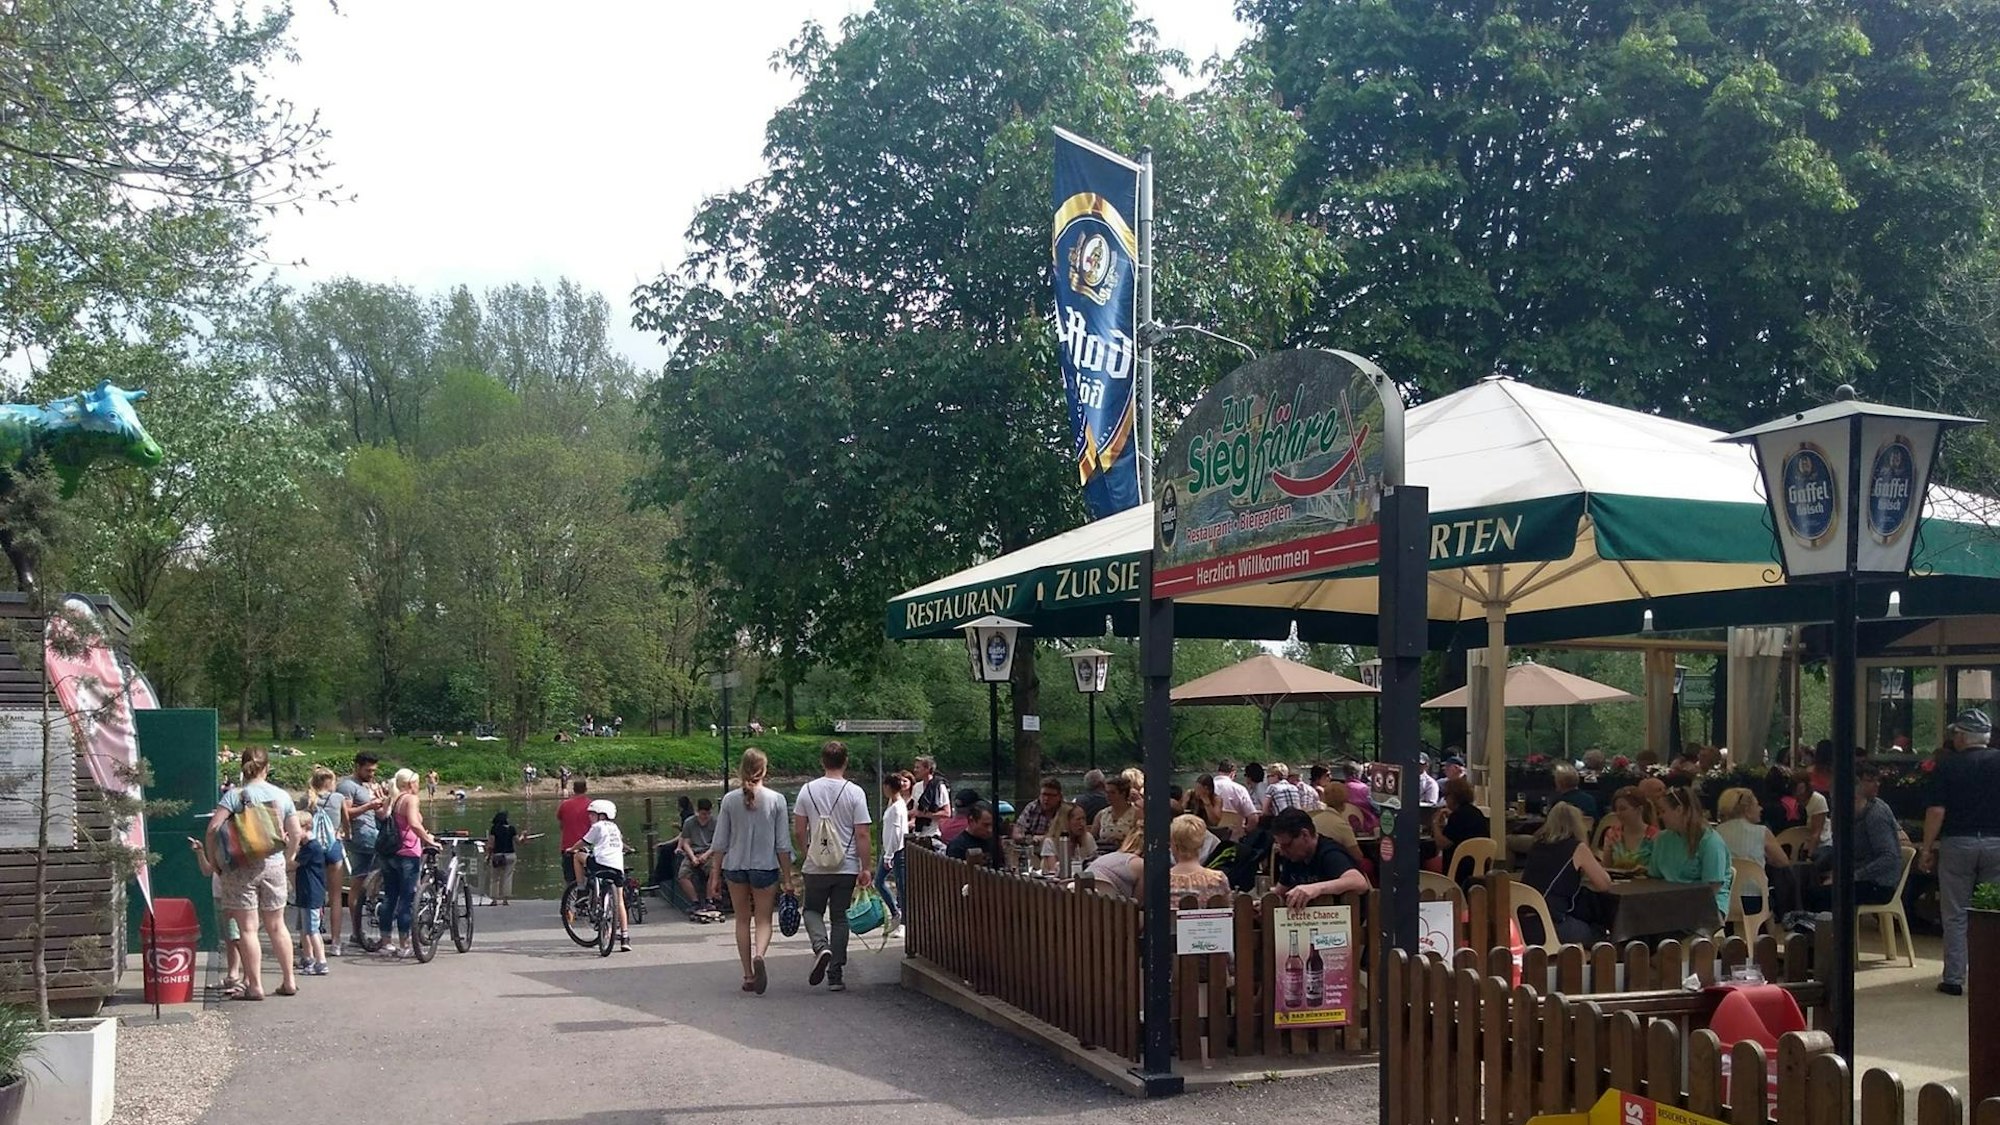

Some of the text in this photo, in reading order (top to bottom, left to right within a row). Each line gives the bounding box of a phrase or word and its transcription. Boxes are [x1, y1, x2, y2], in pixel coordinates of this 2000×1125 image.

[1222, 395, 1254, 436] Zur
[1788, 481, 1830, 504] Gaffel
[1874, 478, 1909, 499] Gaffel
[1186, 503, 1293, 545] Restaurant Biergarten
[1429, 515, 1523, 560] RTEN
[1055, 561, 1141, 601] ZUR SIE
[1196, 549, 1310, 586] Herzlich Willkommen
[905, 584, 1017, 630] RESTAURANT
[1287, 910, 1339, 920] Letzte Chance
